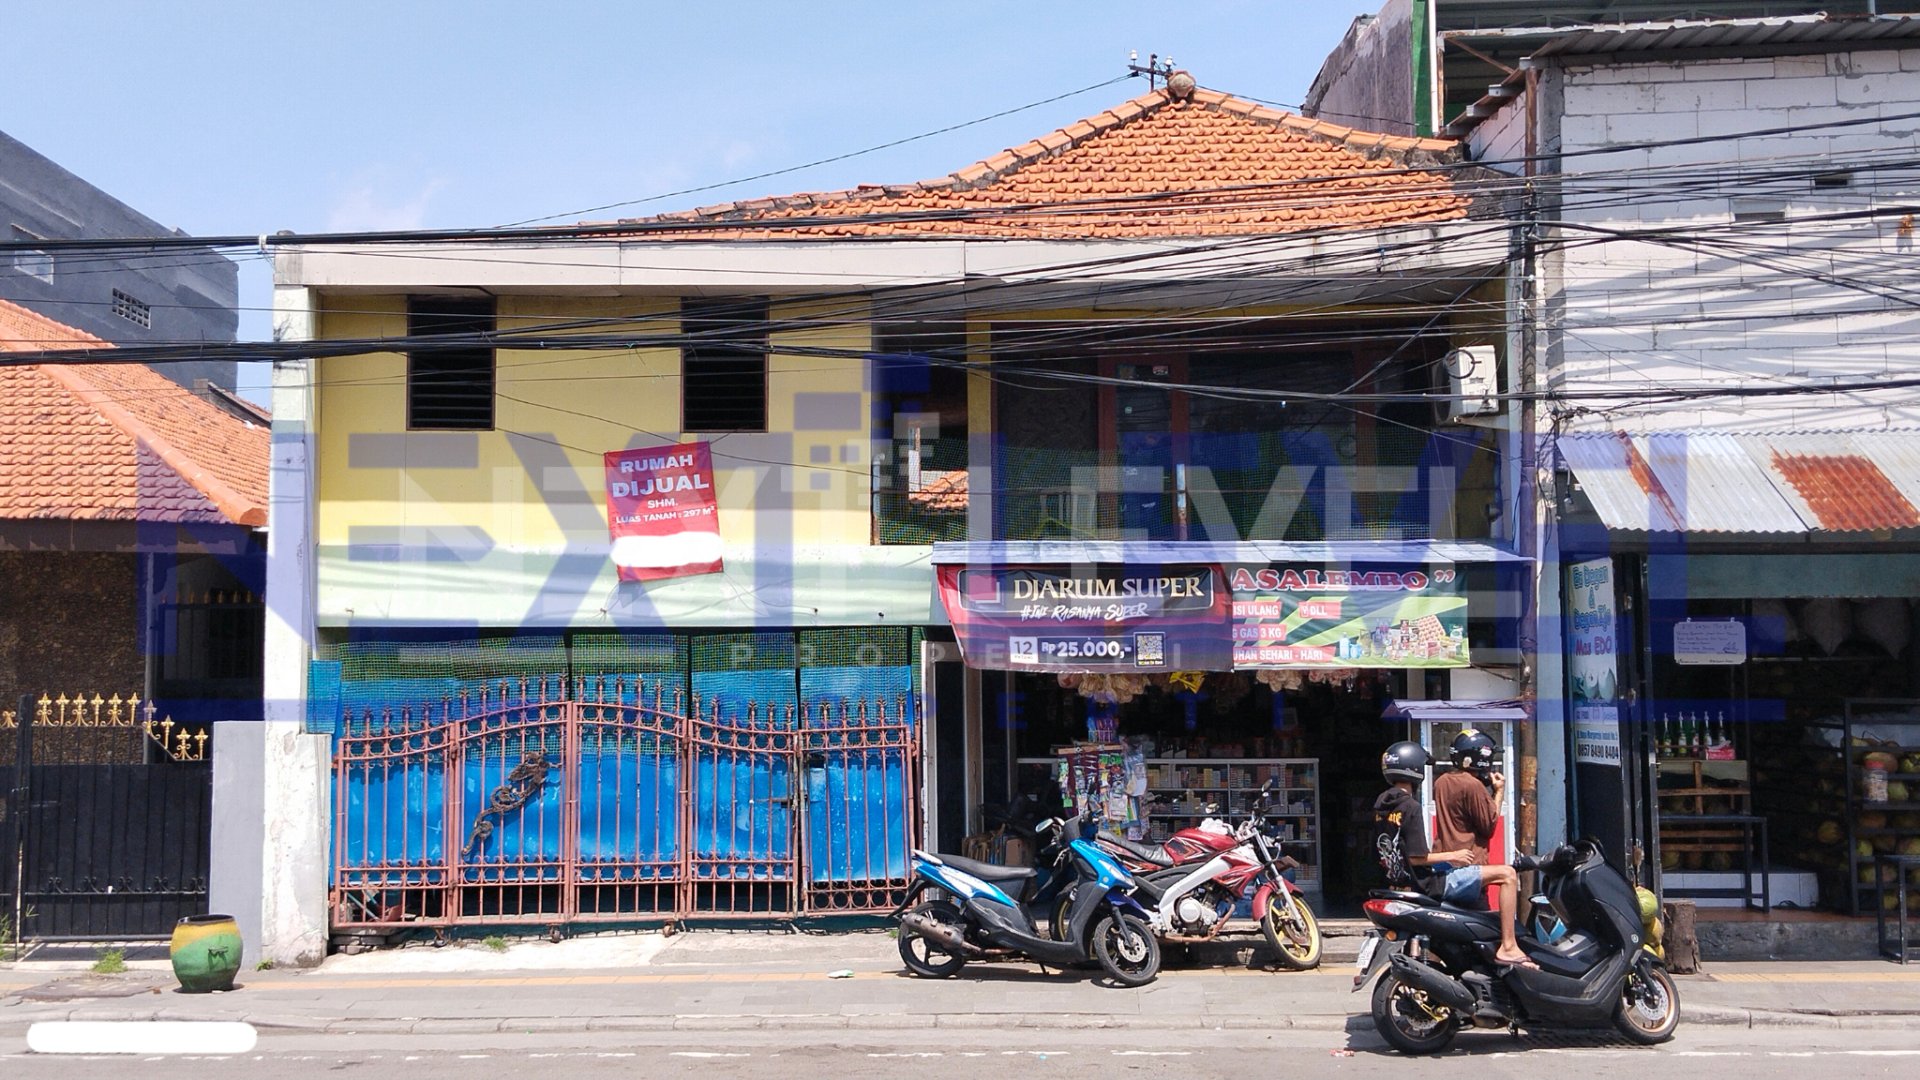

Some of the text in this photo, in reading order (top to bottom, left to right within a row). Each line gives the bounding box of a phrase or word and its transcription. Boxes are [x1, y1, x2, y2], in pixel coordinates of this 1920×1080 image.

[621, 454, 694, 473] RUMAH
[612, 474, 709, 498] DIJUAL
[647, 498, 679, 509] SHM.
[616, 514, 641, 524] LUAS
[643, 511, 677, 522] TANAH
[683, 508, 700, 518] 297
[1014, 577, 1204, 601] DJARUM SUPER
[1248, 605, 1279, 616] ULANG
[1239, 629, 1258, 638] GAS
[1260, 629, 1267, 638] 3
[1268, 629, 1282, 638] KG
[1014, 641, 1033, 655] 12
[1576, 635, 1613, 656] Mas EDO
[1259, 650, 1293, 660] SEHARI
[1300, 650, 1323, 660] HARI
